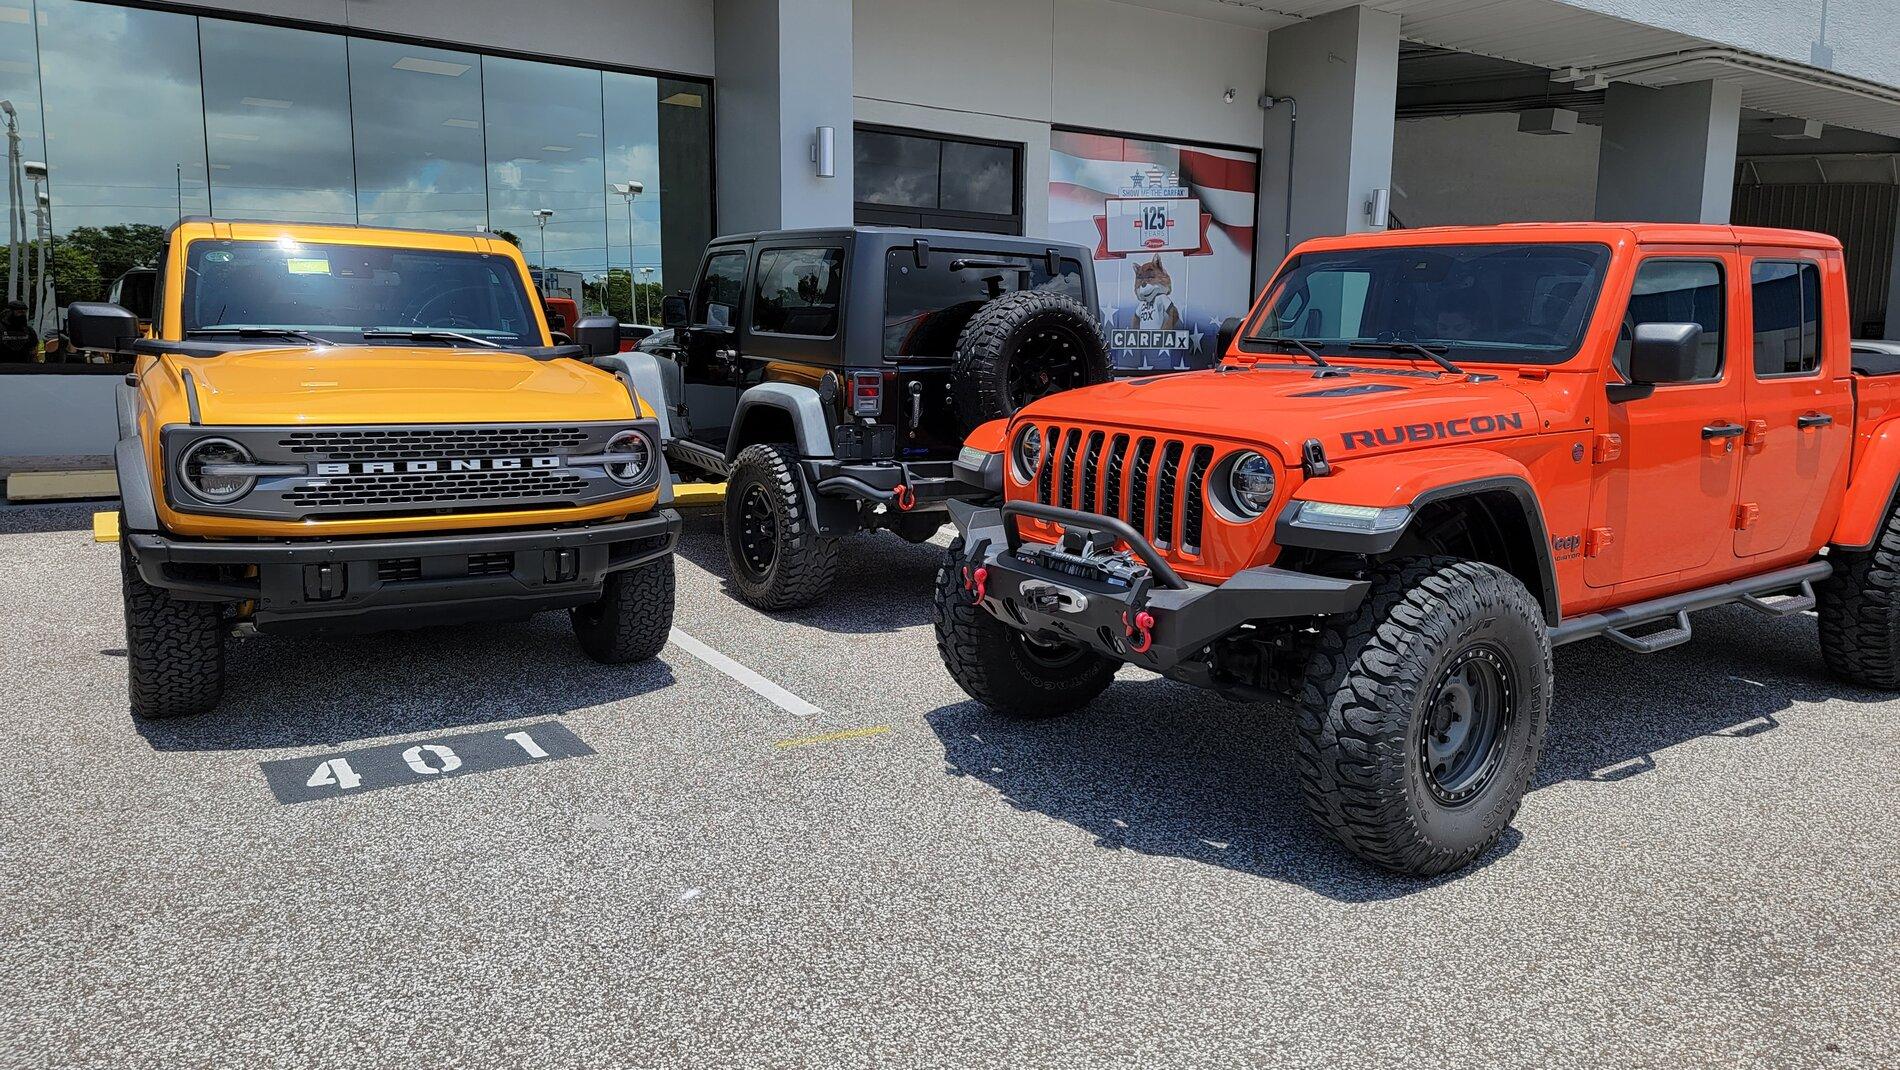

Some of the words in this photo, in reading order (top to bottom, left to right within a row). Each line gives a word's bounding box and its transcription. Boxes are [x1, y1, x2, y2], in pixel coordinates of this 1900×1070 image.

[1122, 189, 1139, 197] SHOW
[1163, 189, 1184, 197] CARFAX
[1142, 206, 1166, 230] 125
[1140, 309, 1155, 321] FOX
[1113, 332, 1187, 348] CARFAX
[1340, 412, 1523, 450] RUBICON
[317, 457, 560, 475] BRONCO
